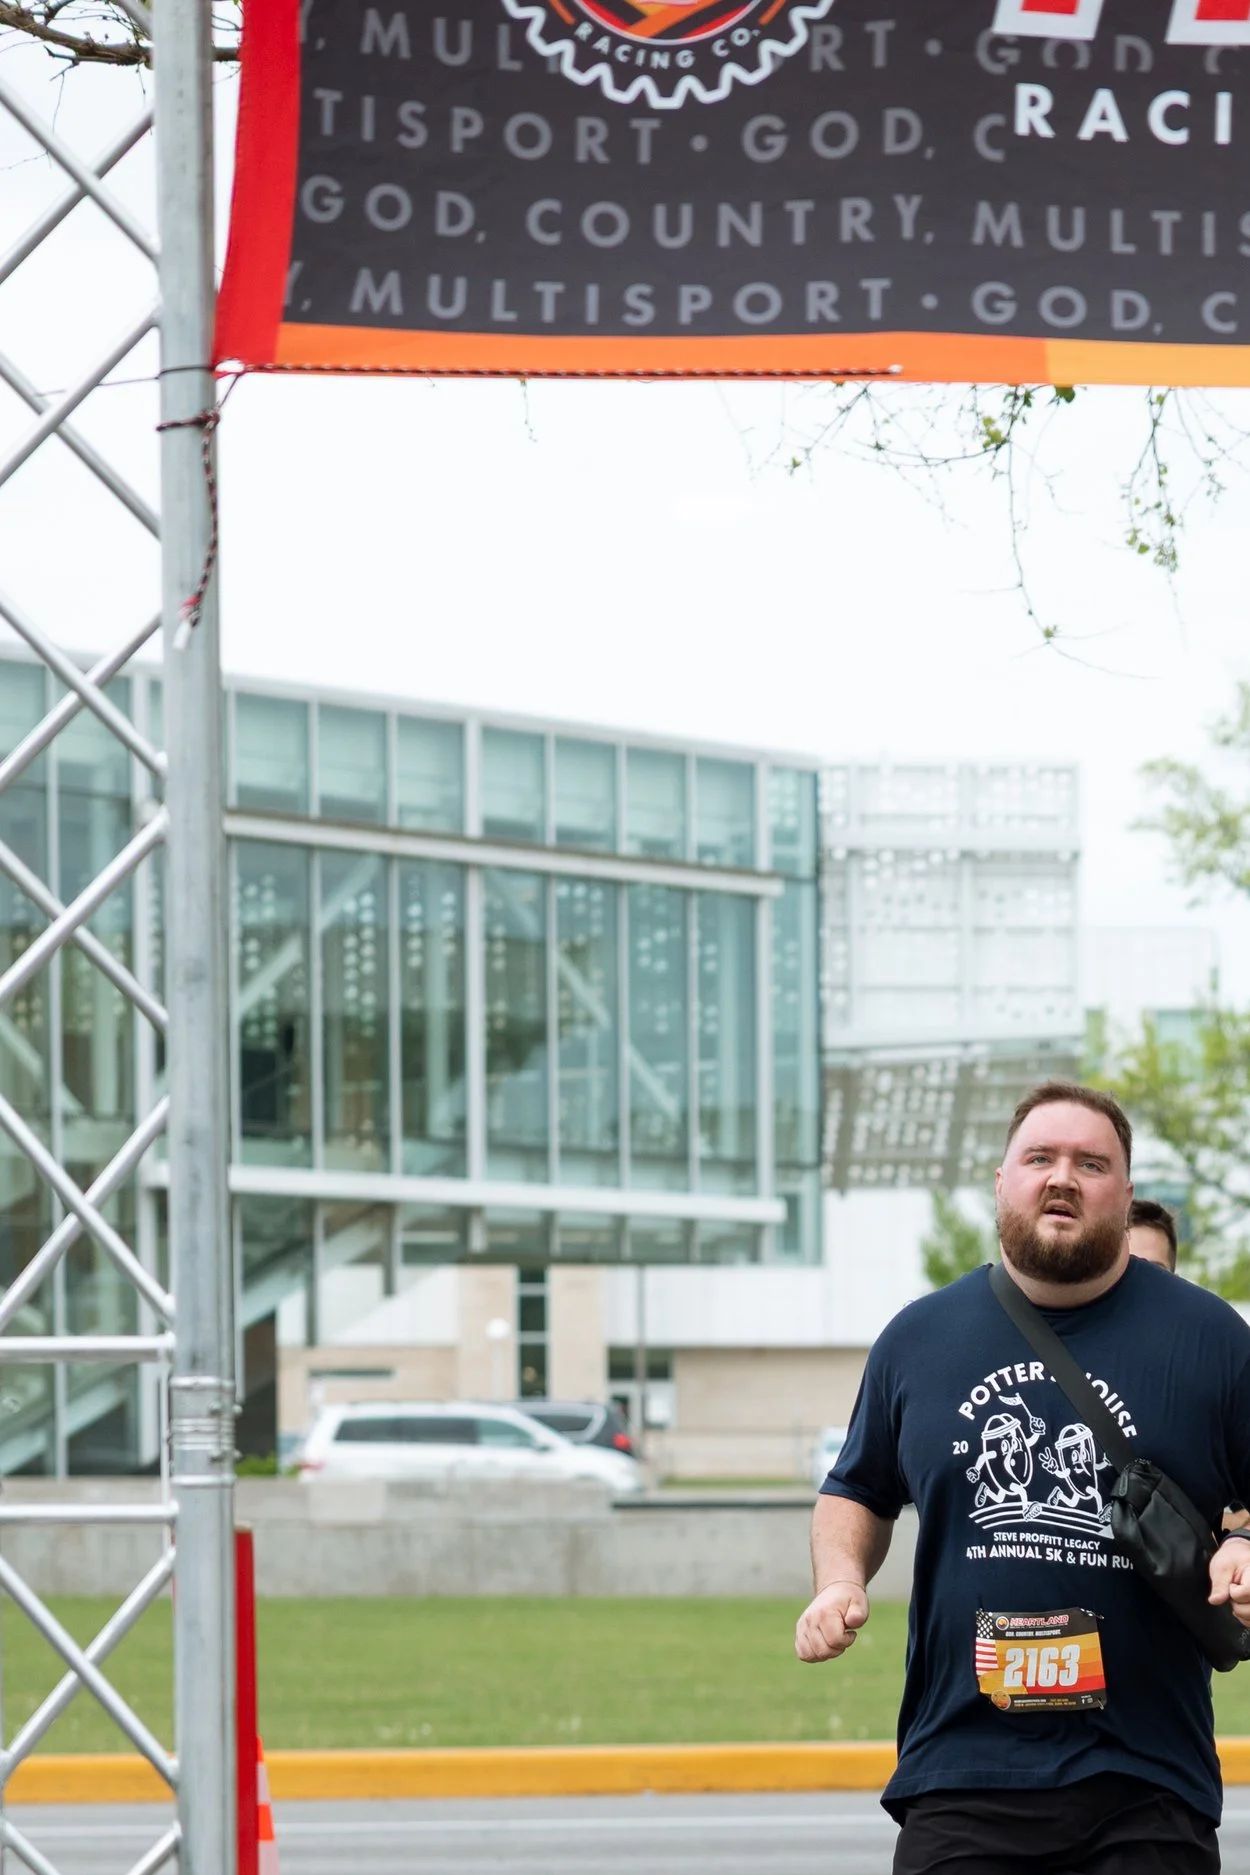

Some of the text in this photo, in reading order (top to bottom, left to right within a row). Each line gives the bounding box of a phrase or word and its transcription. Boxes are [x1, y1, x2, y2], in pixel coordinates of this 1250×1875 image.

[573, 21, 695, 69] RACING
[741, 107, 935, 164] GOD,
[301, 175, 487, 244] GOD,
[525, 193, 935, 250] COUNTRY,
[350, 267, 893, 326] MULTISPORT
[971, 280, 1165, 335] GOD,
[952, 1440, 969, 1455] 20
[966, 1545, 987, 1560] 4TH
[989, 1545, 1042, 1559] ANNUAL
[1066, 1551, 1076, 1565] &
[1079, 1552, 1108, 1567] FUN
[993, 1532, 1101, 1550] STEVE PROFFITT LEGACY
[1010, 1614, 1069, 1626] HEARTLAND
[1003, 1644, 1080, 1687] 2163
